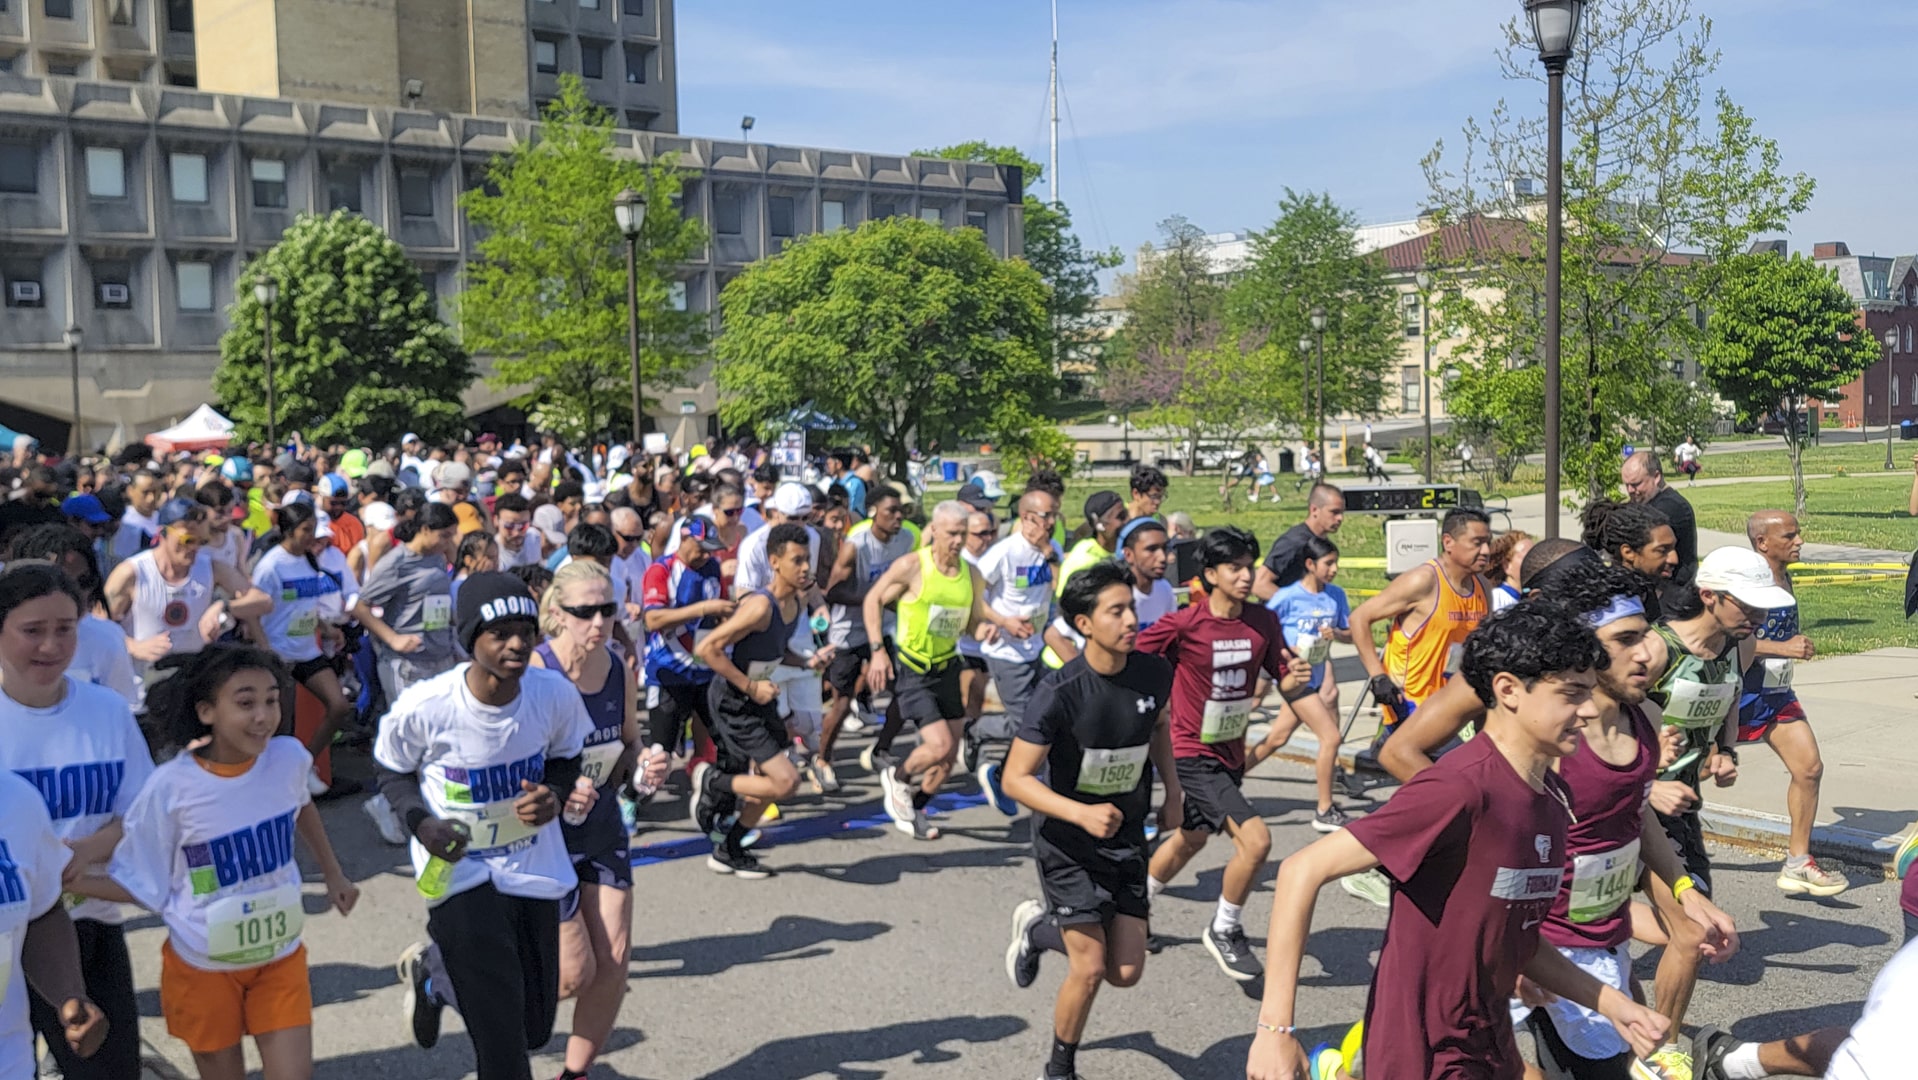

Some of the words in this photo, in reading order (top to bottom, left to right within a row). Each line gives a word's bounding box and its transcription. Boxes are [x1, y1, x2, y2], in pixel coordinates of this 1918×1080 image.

[1687, 700, 1721, 718] 1689
[1100, 763, 1135, 783] 1502
[487, 822, 499, 846] 7
[209, 806, 297, 888] BRON
[235, 910, 287, 947] 1013
